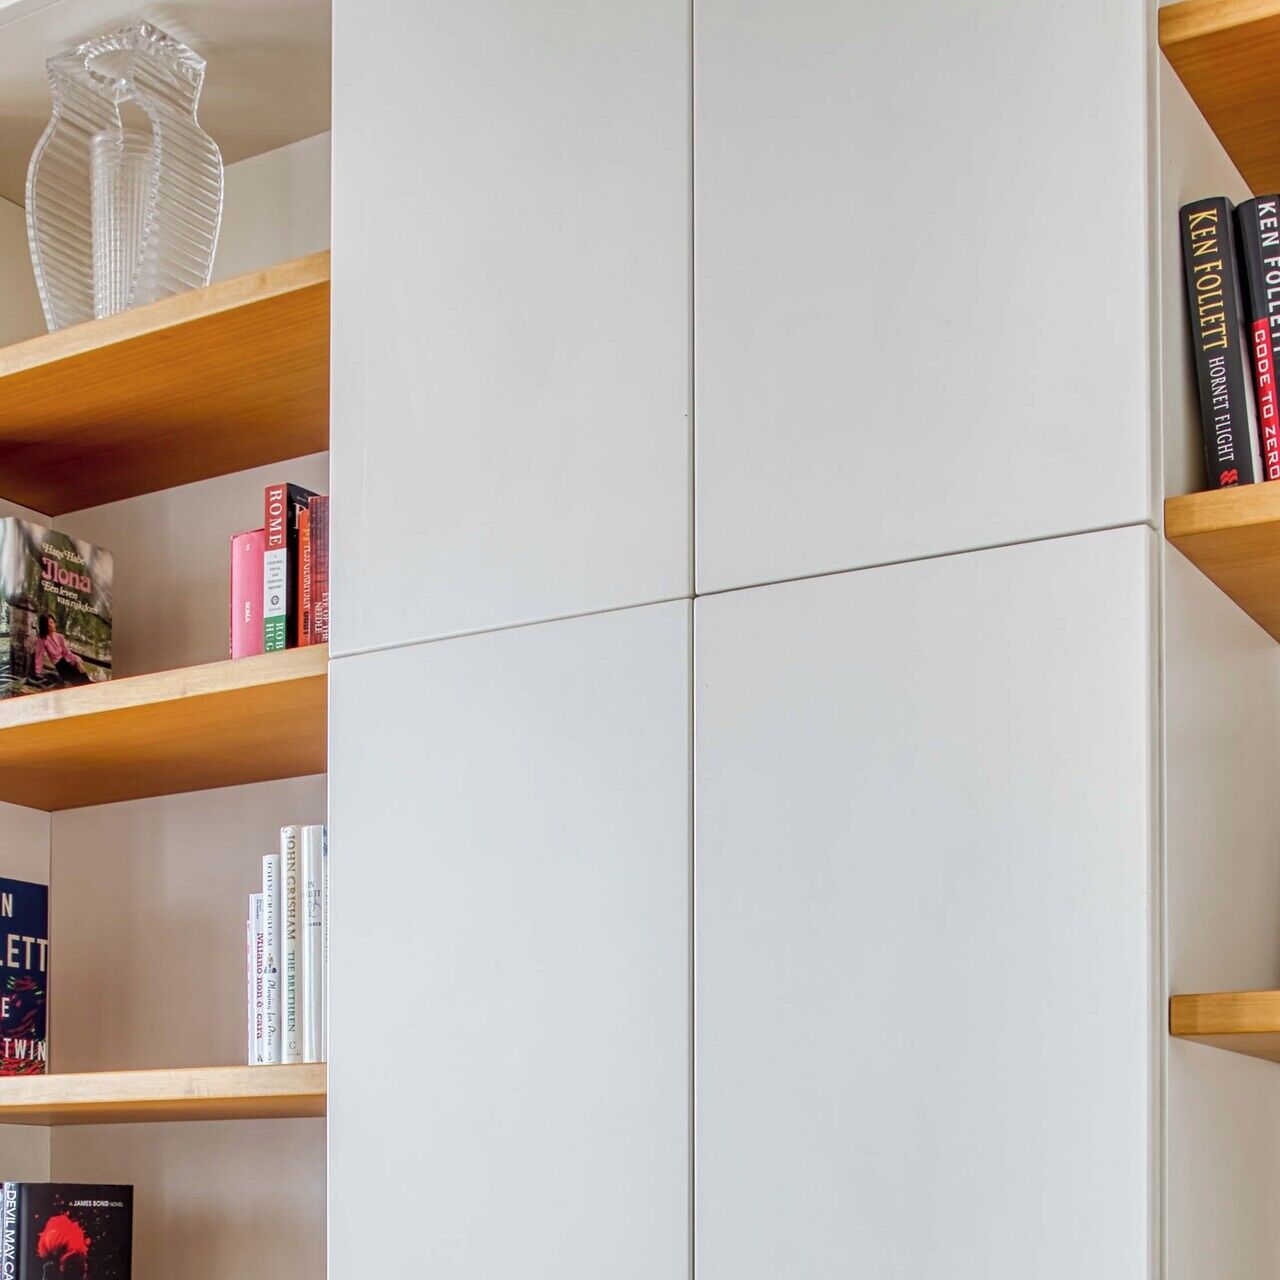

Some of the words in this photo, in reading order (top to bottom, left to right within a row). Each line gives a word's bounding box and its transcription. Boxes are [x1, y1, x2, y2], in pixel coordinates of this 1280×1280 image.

[1188, 208, 1218, 257] KEN
[1257, 201, 1280, 247] KEN
[1193, 259, 1228, 351] FOLLETT
[1254, 328, 1271, 388] CODE
[1208, 356, 1230, 411] HORNET
[1261, 391, 1275, 419] TO
[1214, 413, 1235, 462] FLIGHT
[1264, 425, 1280, 479] ZERO
[269, 488, 282, 546] ROME
[275, 622, 284, 651] ROB
[314, 601, 323, 634] NEEDLE
[286, 834, 296, 872] JOHN
[287, 876, 297, 940] GRISHAM
[287, 950, 296, 973] THE
[256, 976, 264, 999] non
[287, 975, 296, 1033] BRETHREN
[256, 1013, 264, 1040] cara
[3, 1037, 47, 1062] TWIN
[5, 1190, 17, 1227] DEVIL
[4, 1229, 16, 1260] MAY
